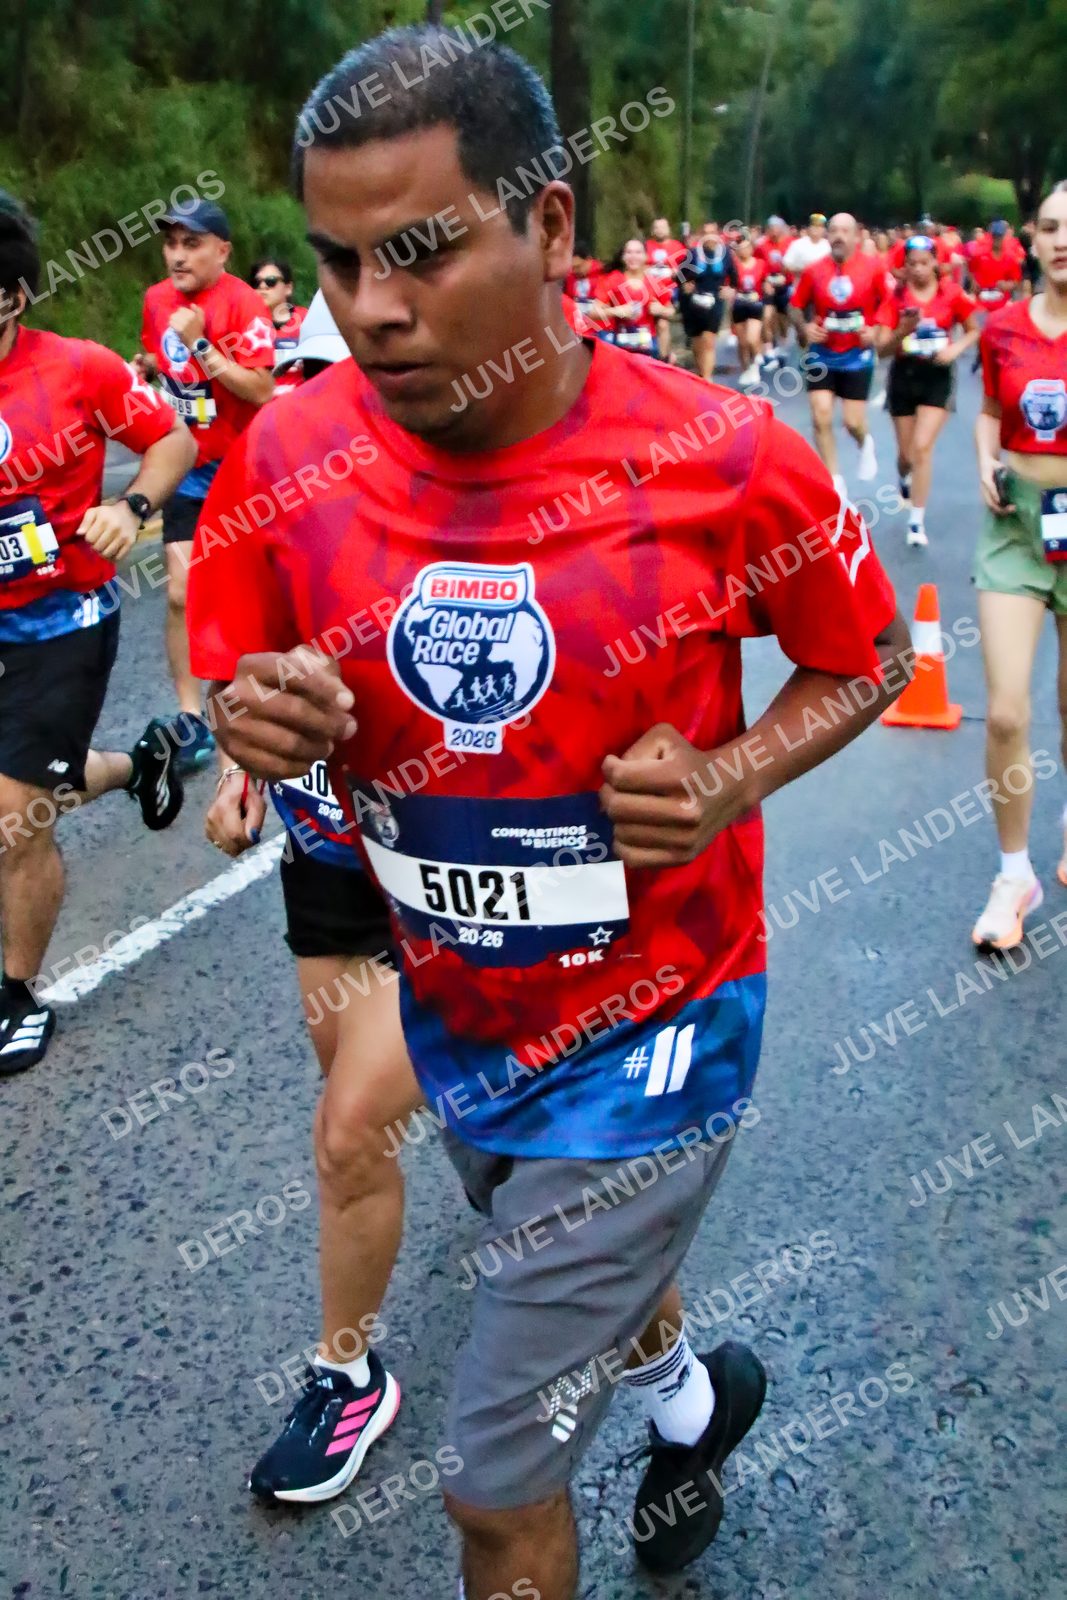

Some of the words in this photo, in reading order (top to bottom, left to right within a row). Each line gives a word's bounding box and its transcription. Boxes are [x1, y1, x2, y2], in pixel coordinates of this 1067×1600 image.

[430, 578, 518, 600] BIMBO
[429, 610, 515, 641] Global
[412, 635, 480, 666] Race
[450, 728, 497, 749] 2026
[491, 825, 587, 838] COMPARTIMOS
[419, 863, 531, 921] 5021
[559, 949, 604, 968] 10K
